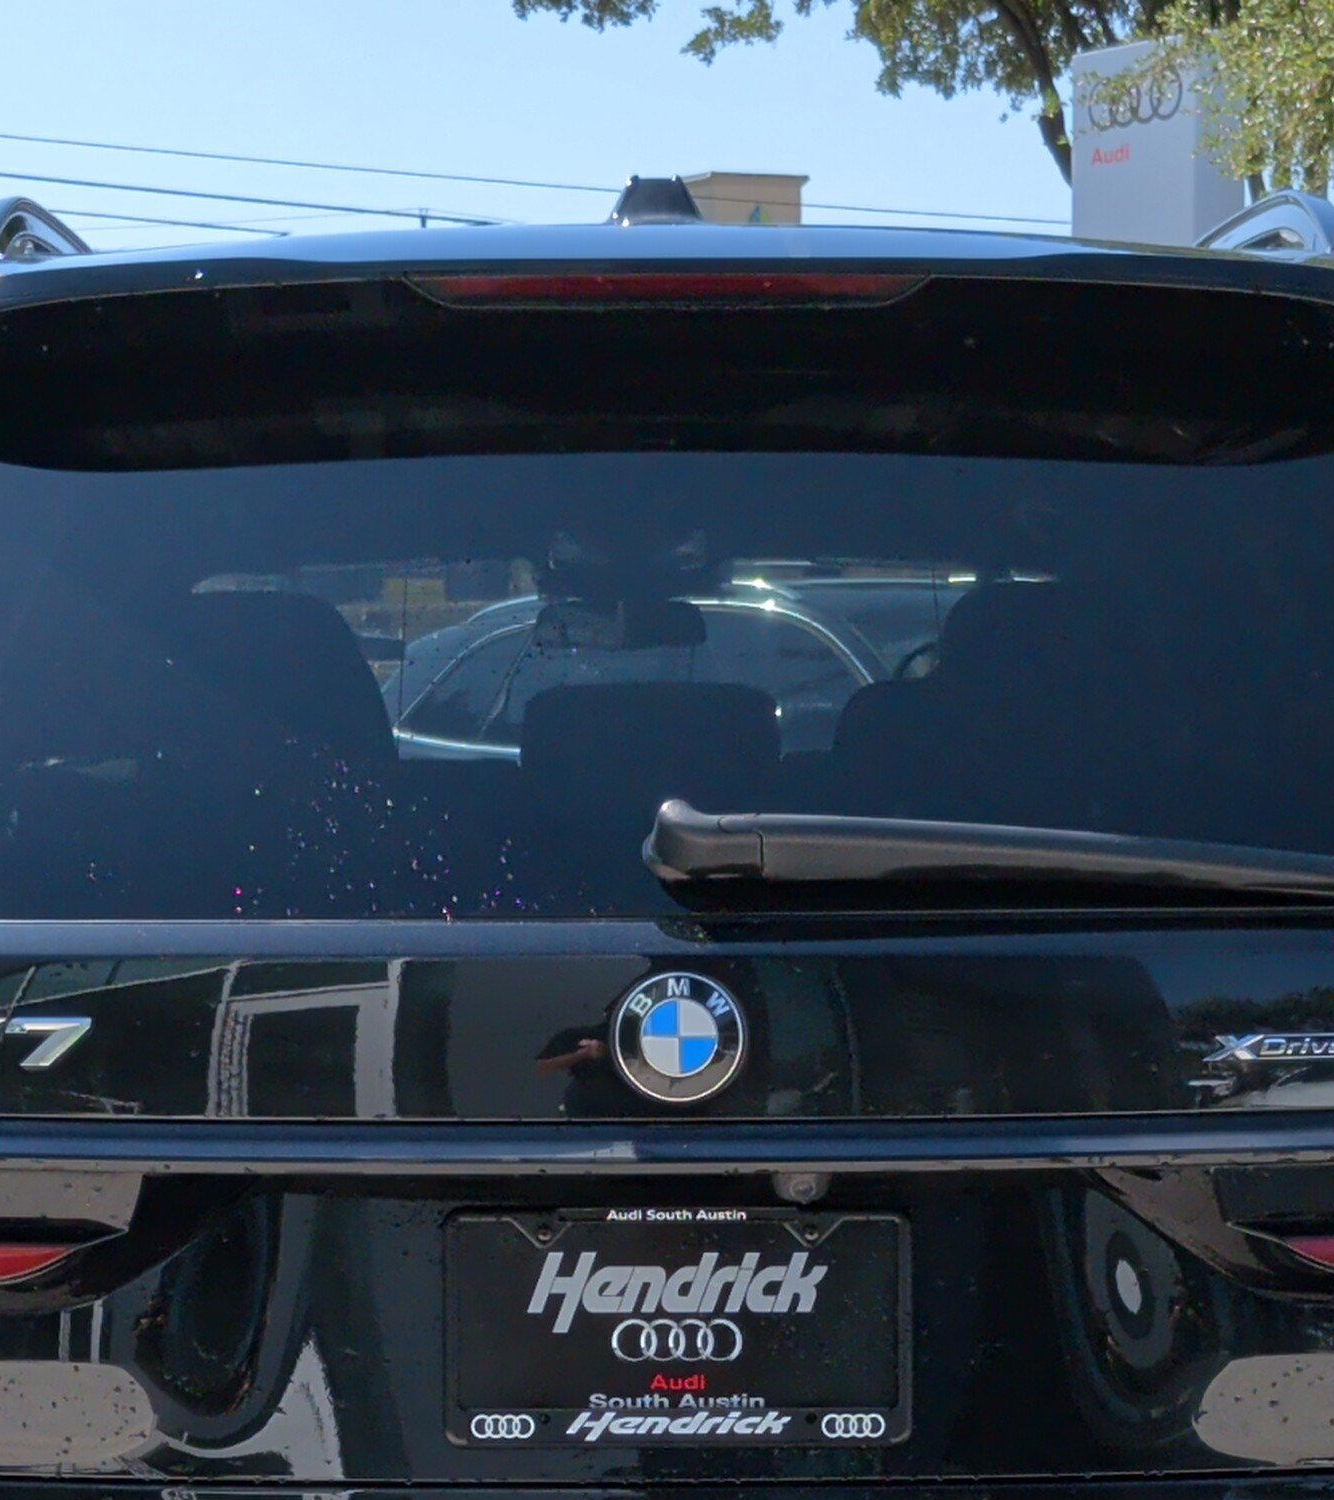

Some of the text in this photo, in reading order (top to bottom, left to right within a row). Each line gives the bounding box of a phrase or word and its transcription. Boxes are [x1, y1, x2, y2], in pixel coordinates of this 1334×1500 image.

[1091, 143, 1130, 166] Audi
[629, 977, 730, 1018] BMW
[606, 1209, 747, 1221] Audi South Austin
[527, 1251, 829, 1334] Hendrick
[650, 1374, 706, 1390] Audi
[588, 1393, 766, 1409] South Austin
[565, 1411, 792, 1442] Hendrick
